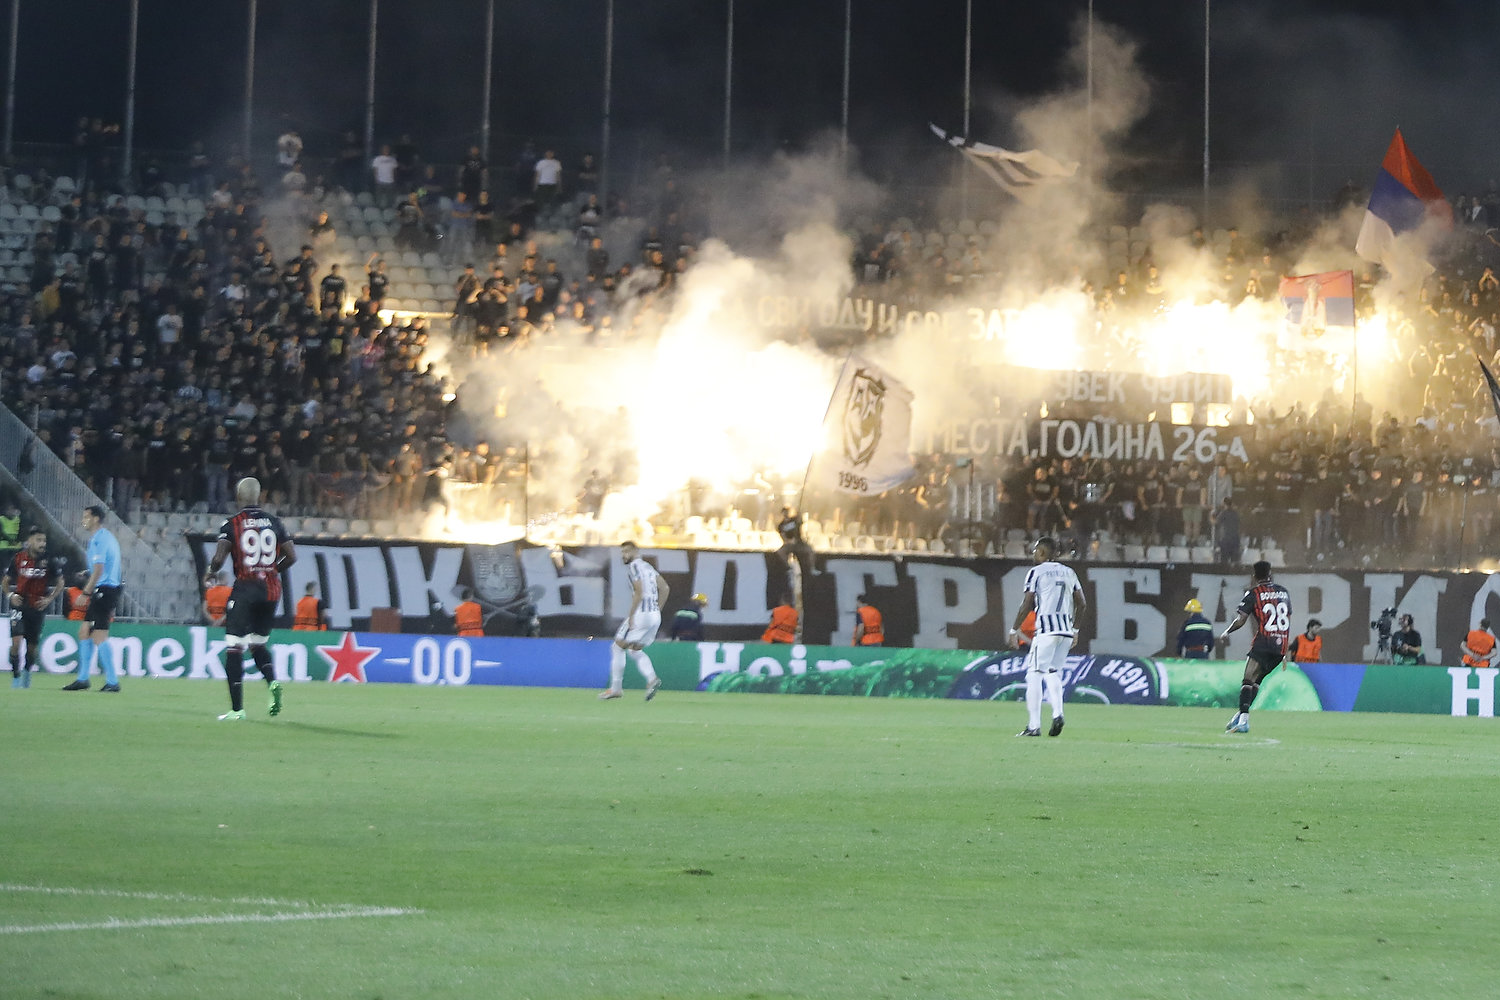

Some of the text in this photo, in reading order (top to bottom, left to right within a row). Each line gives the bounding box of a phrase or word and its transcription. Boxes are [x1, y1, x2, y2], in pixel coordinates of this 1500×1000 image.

[839, 471, 868, 492] 1996
[242, 528, 277, 567] 99
[1055, 581, 1066, 613] 7
[1262, 602, 1290, 632] 28
